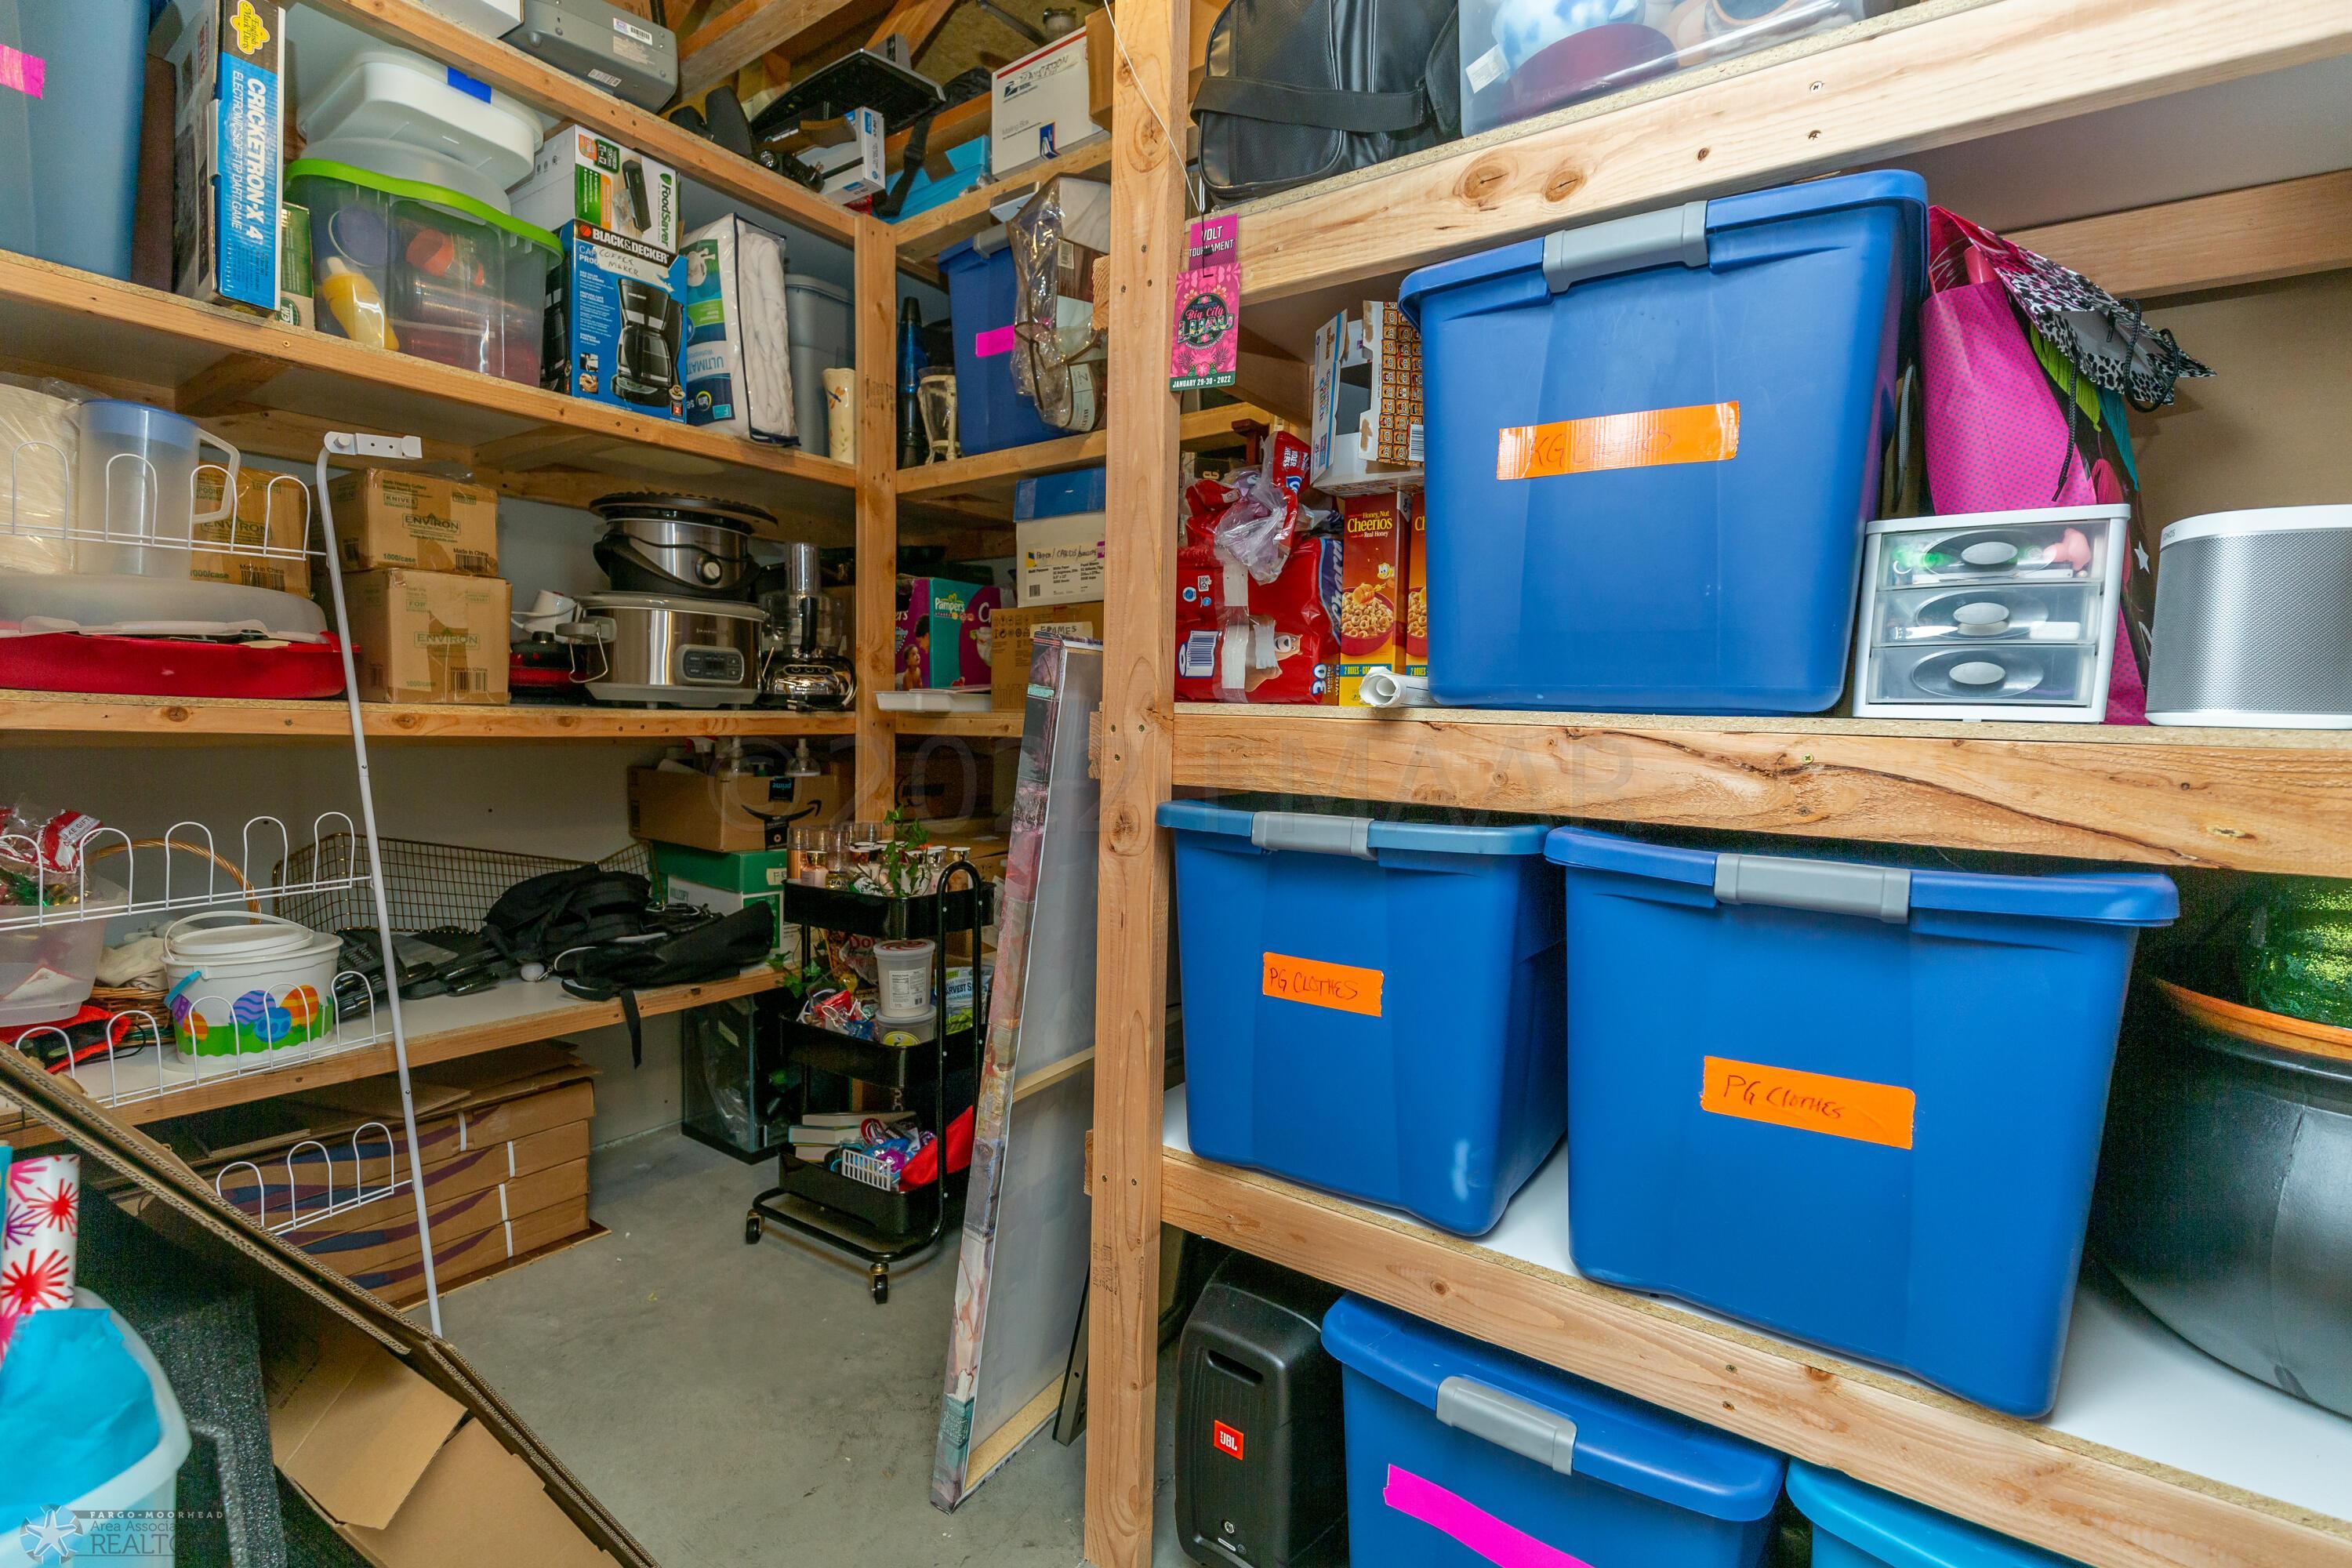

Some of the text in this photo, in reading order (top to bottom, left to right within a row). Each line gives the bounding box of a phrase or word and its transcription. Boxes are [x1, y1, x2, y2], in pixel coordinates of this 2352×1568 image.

[232, 71, 244, 129] ELECTRONIC
[231, 174, 243, 201] DART
[231, 201, 243, 230] GAME
[660, 184, 673, 248] FoodSaver
[246, 226, 263, 245] 4
[593, 228, 668, 264] BLACK&DECKER
[1189, 238, 1234, 258] TOUAMENT
[1185, 306, 1224, 321] Big City
[687, 357, 724, 375] ULTIMAT
[1172, 379, 1196, 389] JANUARY
[1217, 375, 1232, 384] 2022
[203, 519, 270, 533] ENVRON
[405, 514, 459, 530] ENVIRON
[1347, 517, 1393, 533] Cheerios
[935, 597, 965, 613] Pampers
[417, 633, 478, 645] ENVIRON
[1040, 625, 1077, 636] FRAMES
[1312, 664, 1327, 695] 30
[77, 816, 90, 829] GIFT
[946, 982, 967, 996] ARVEST
[1270, 967, 1359, 1000] PG CLOTHES
[1724, 1074, 1761, 1106] PG
[1219, 1430, 1238, 1451] JBL
